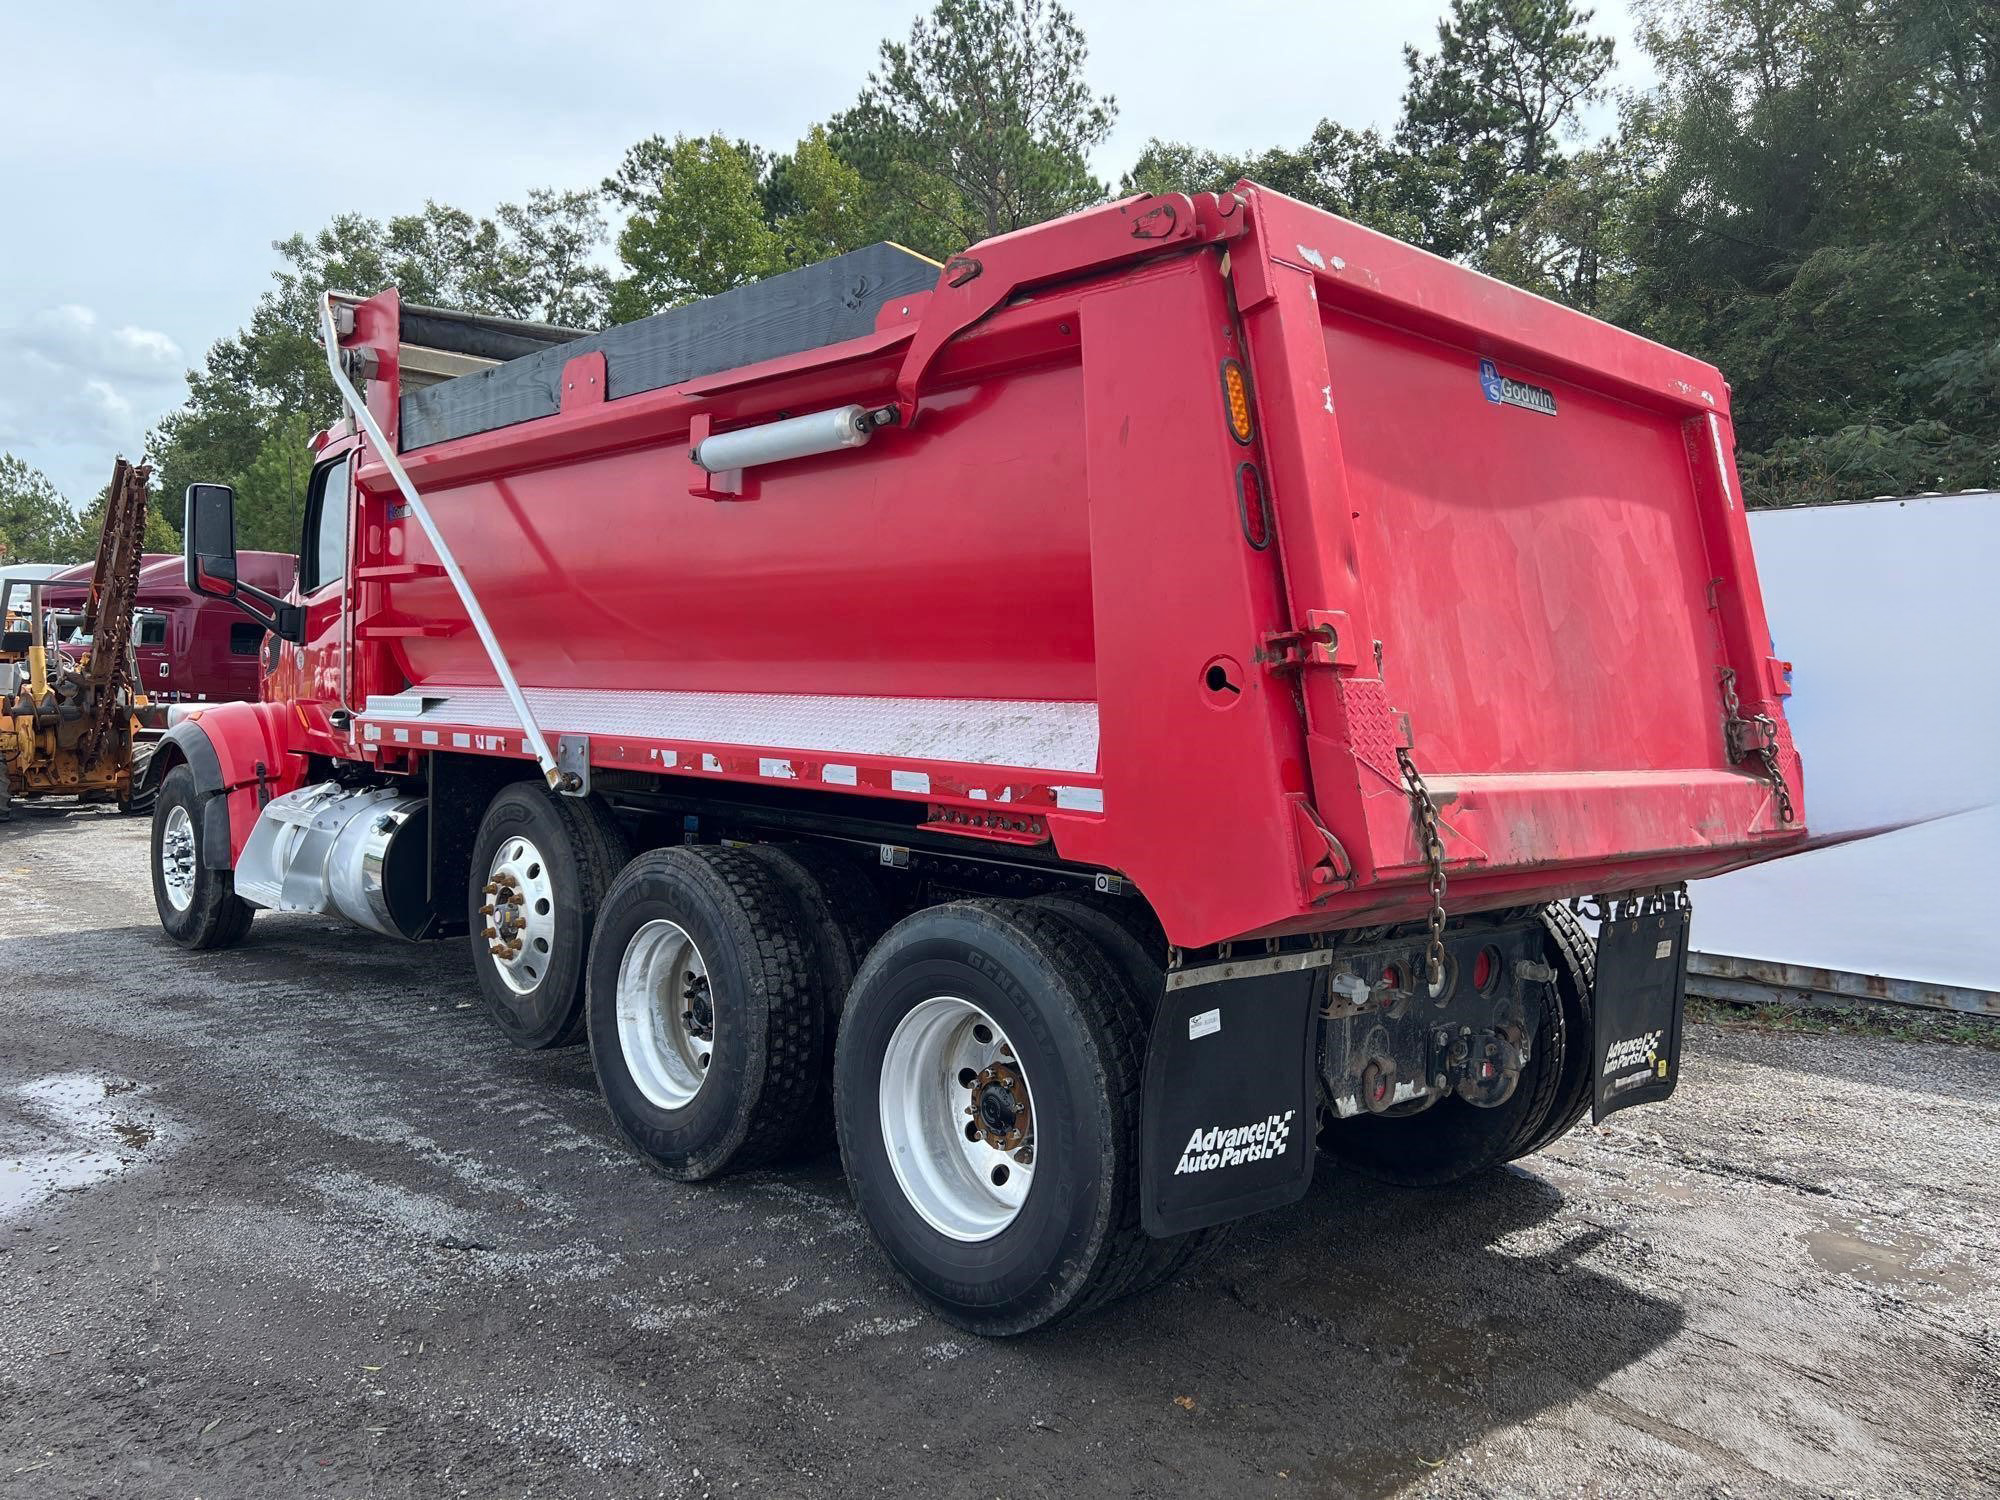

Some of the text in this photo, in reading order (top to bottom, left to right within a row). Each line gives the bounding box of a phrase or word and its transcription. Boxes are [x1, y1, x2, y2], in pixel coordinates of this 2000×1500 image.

[1501, 377, 1552, 409] Godwin
[1606, 1037, 1643, 1061] Advance
[1184, 1121, 1267, 1154] Advance
[1174, 1142, 1262, 1176] Auto Parts
